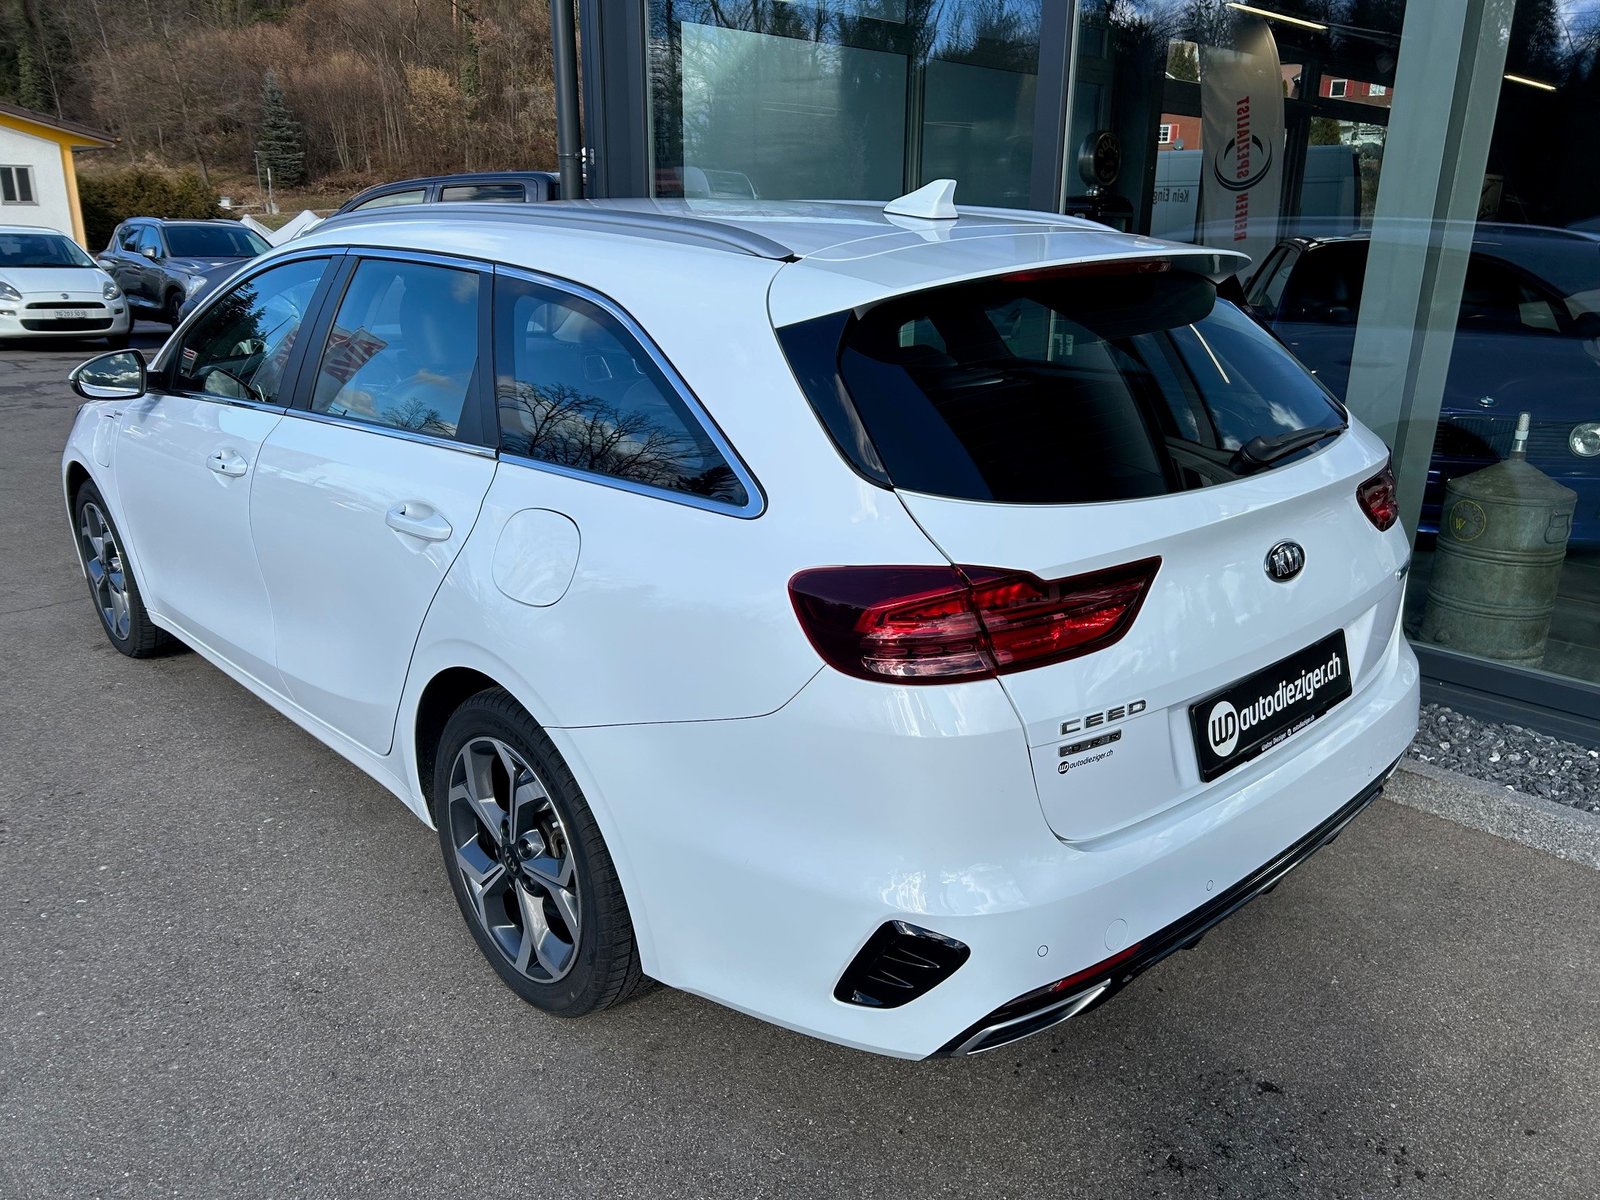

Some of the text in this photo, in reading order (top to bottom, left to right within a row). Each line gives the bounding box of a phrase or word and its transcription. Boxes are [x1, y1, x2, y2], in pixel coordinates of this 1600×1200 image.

[1240, 652, 1341, 731] autodieziger.ch
[1060, 699, 1146, 735] CEED
[1069, 749, 1113, 769] autodieziger.ch
